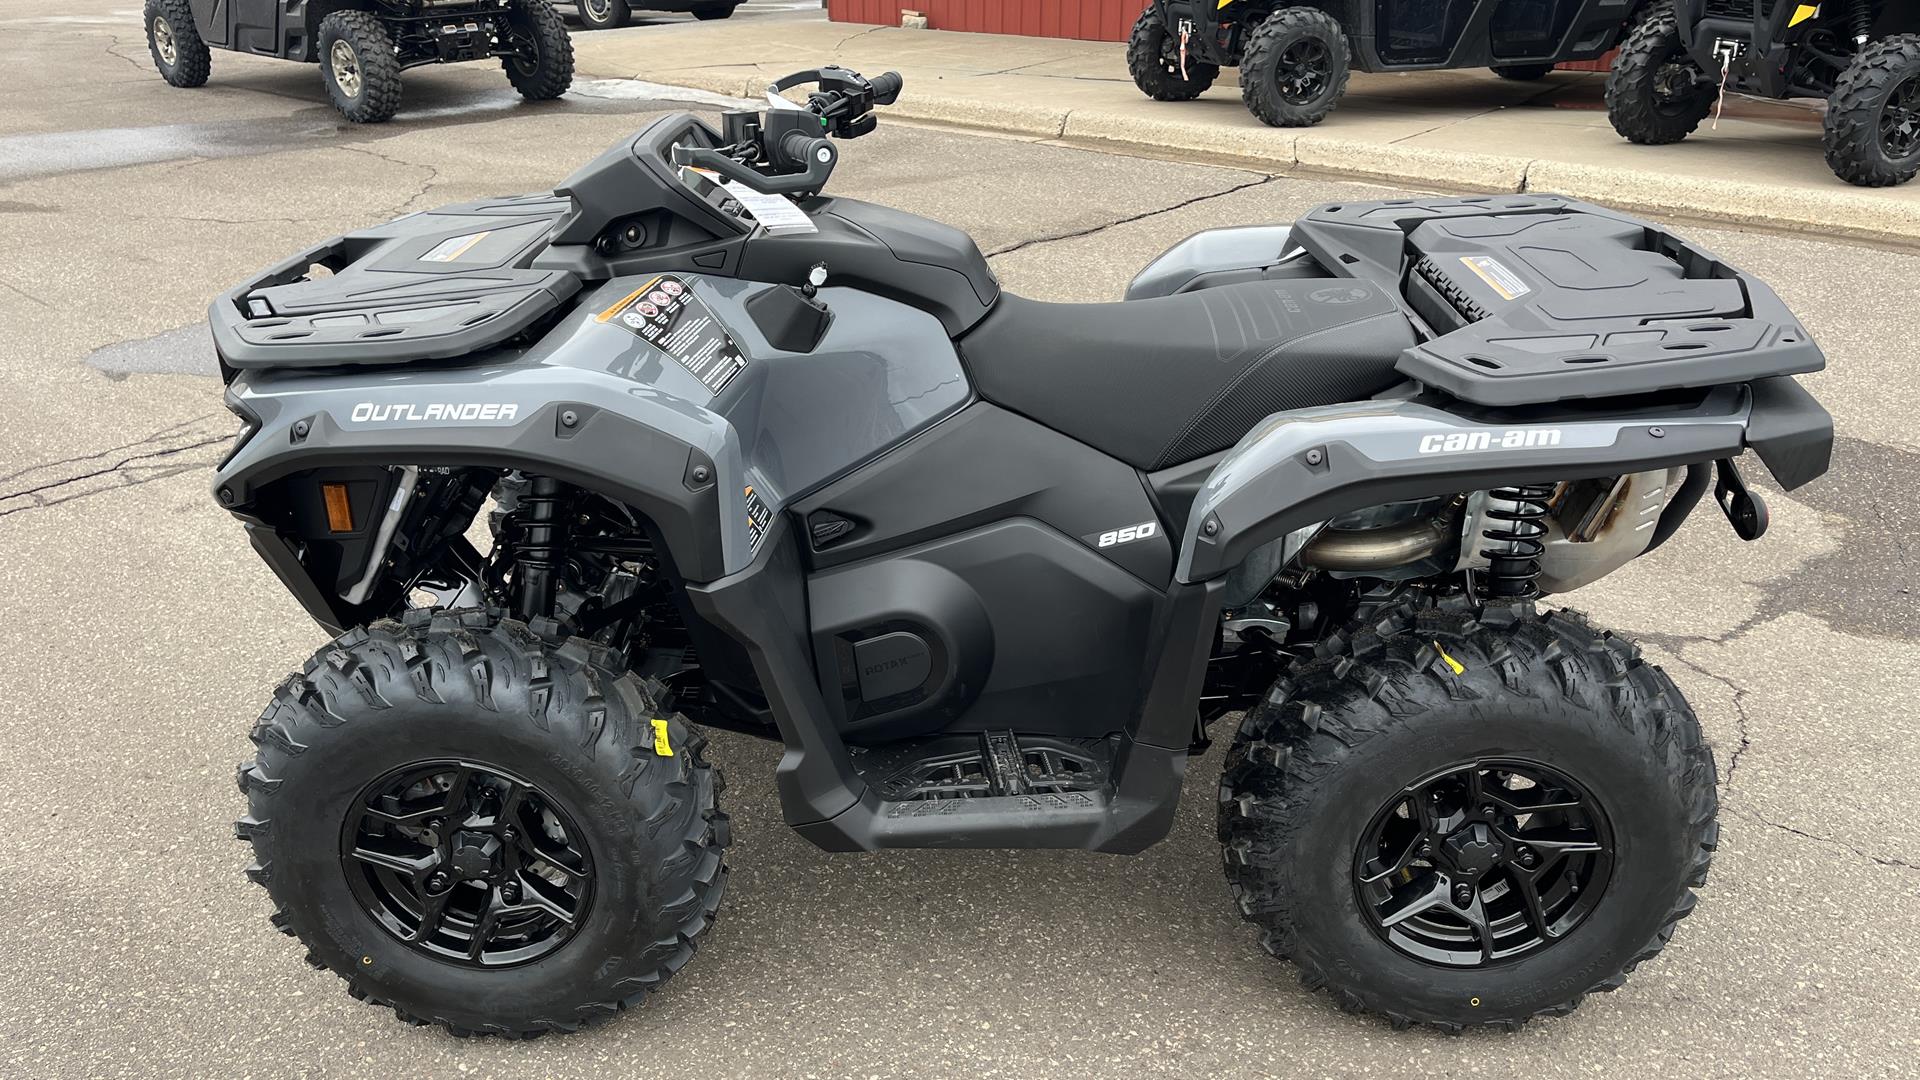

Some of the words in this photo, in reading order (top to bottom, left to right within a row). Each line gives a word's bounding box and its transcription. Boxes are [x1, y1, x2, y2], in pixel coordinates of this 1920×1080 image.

[351, 402, 519, 422] OUTLANDER
[1418, 429, 1562, 454] can-am
[1098, 522, 1156, 547] 850
